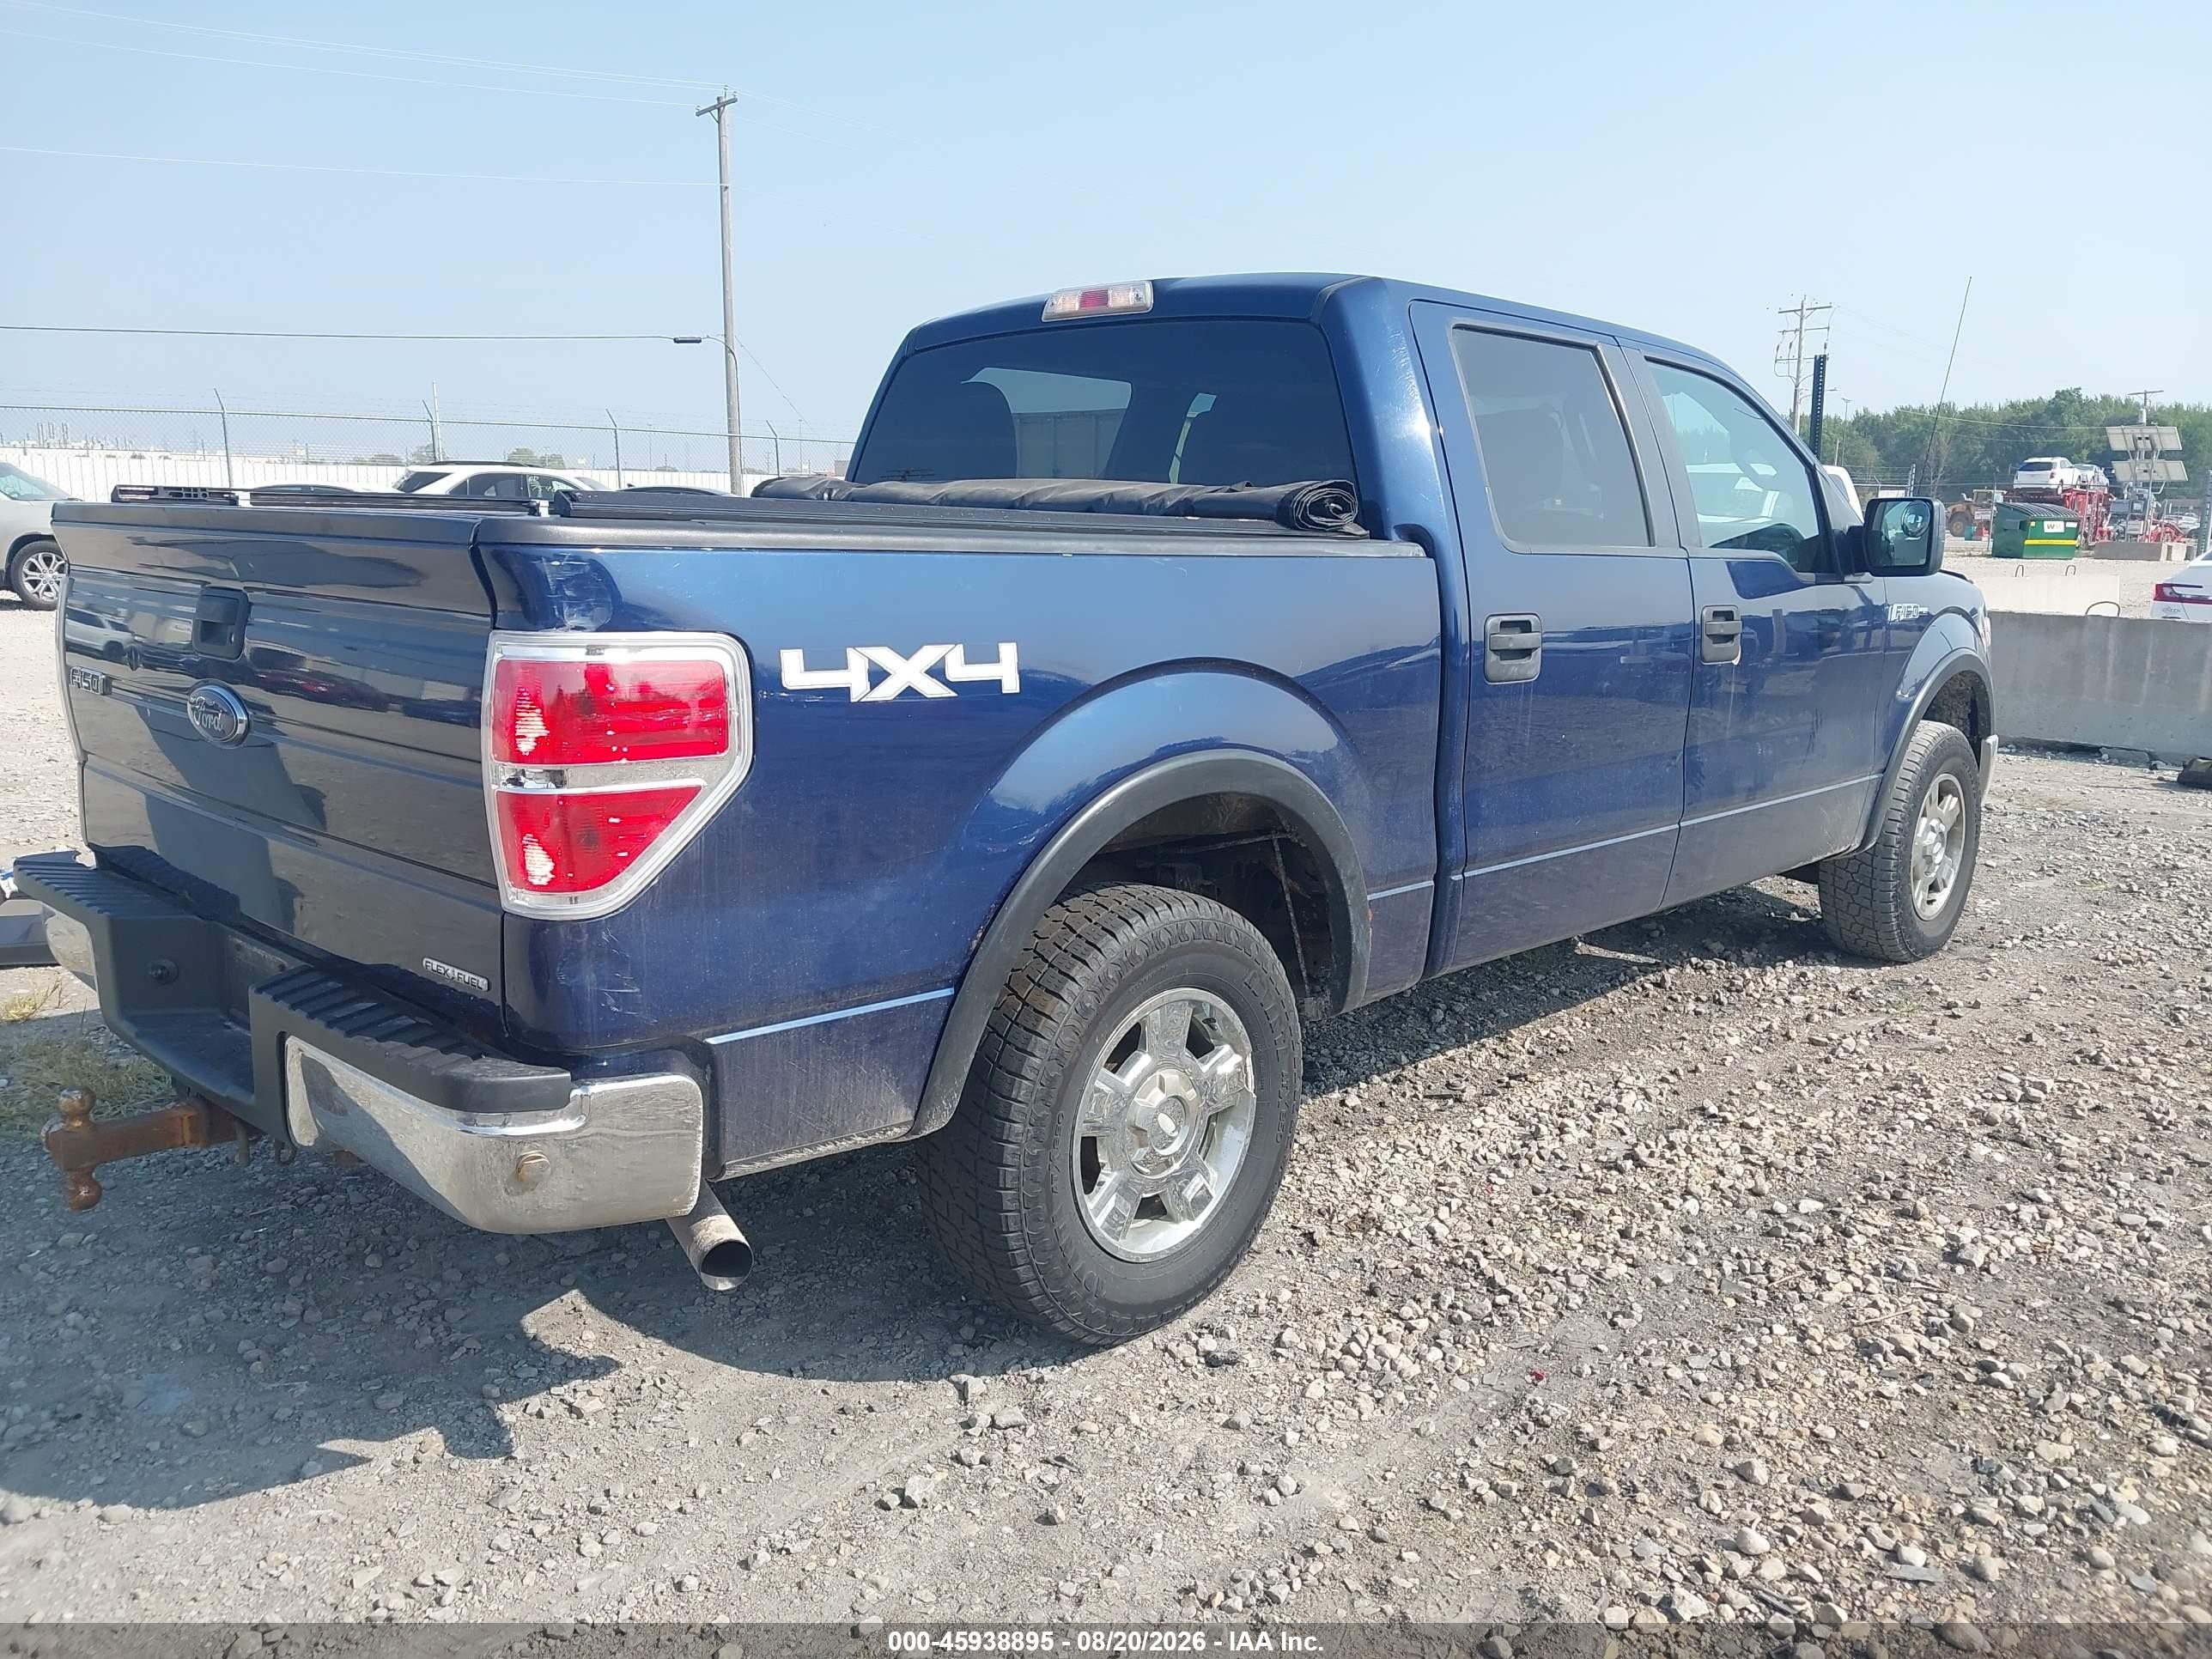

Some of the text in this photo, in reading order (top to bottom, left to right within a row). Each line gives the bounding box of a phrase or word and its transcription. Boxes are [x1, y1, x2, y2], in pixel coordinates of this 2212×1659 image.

[189, 695, 227, 732] Ford
[425, 960, 483, 990] FLEX FUEL
